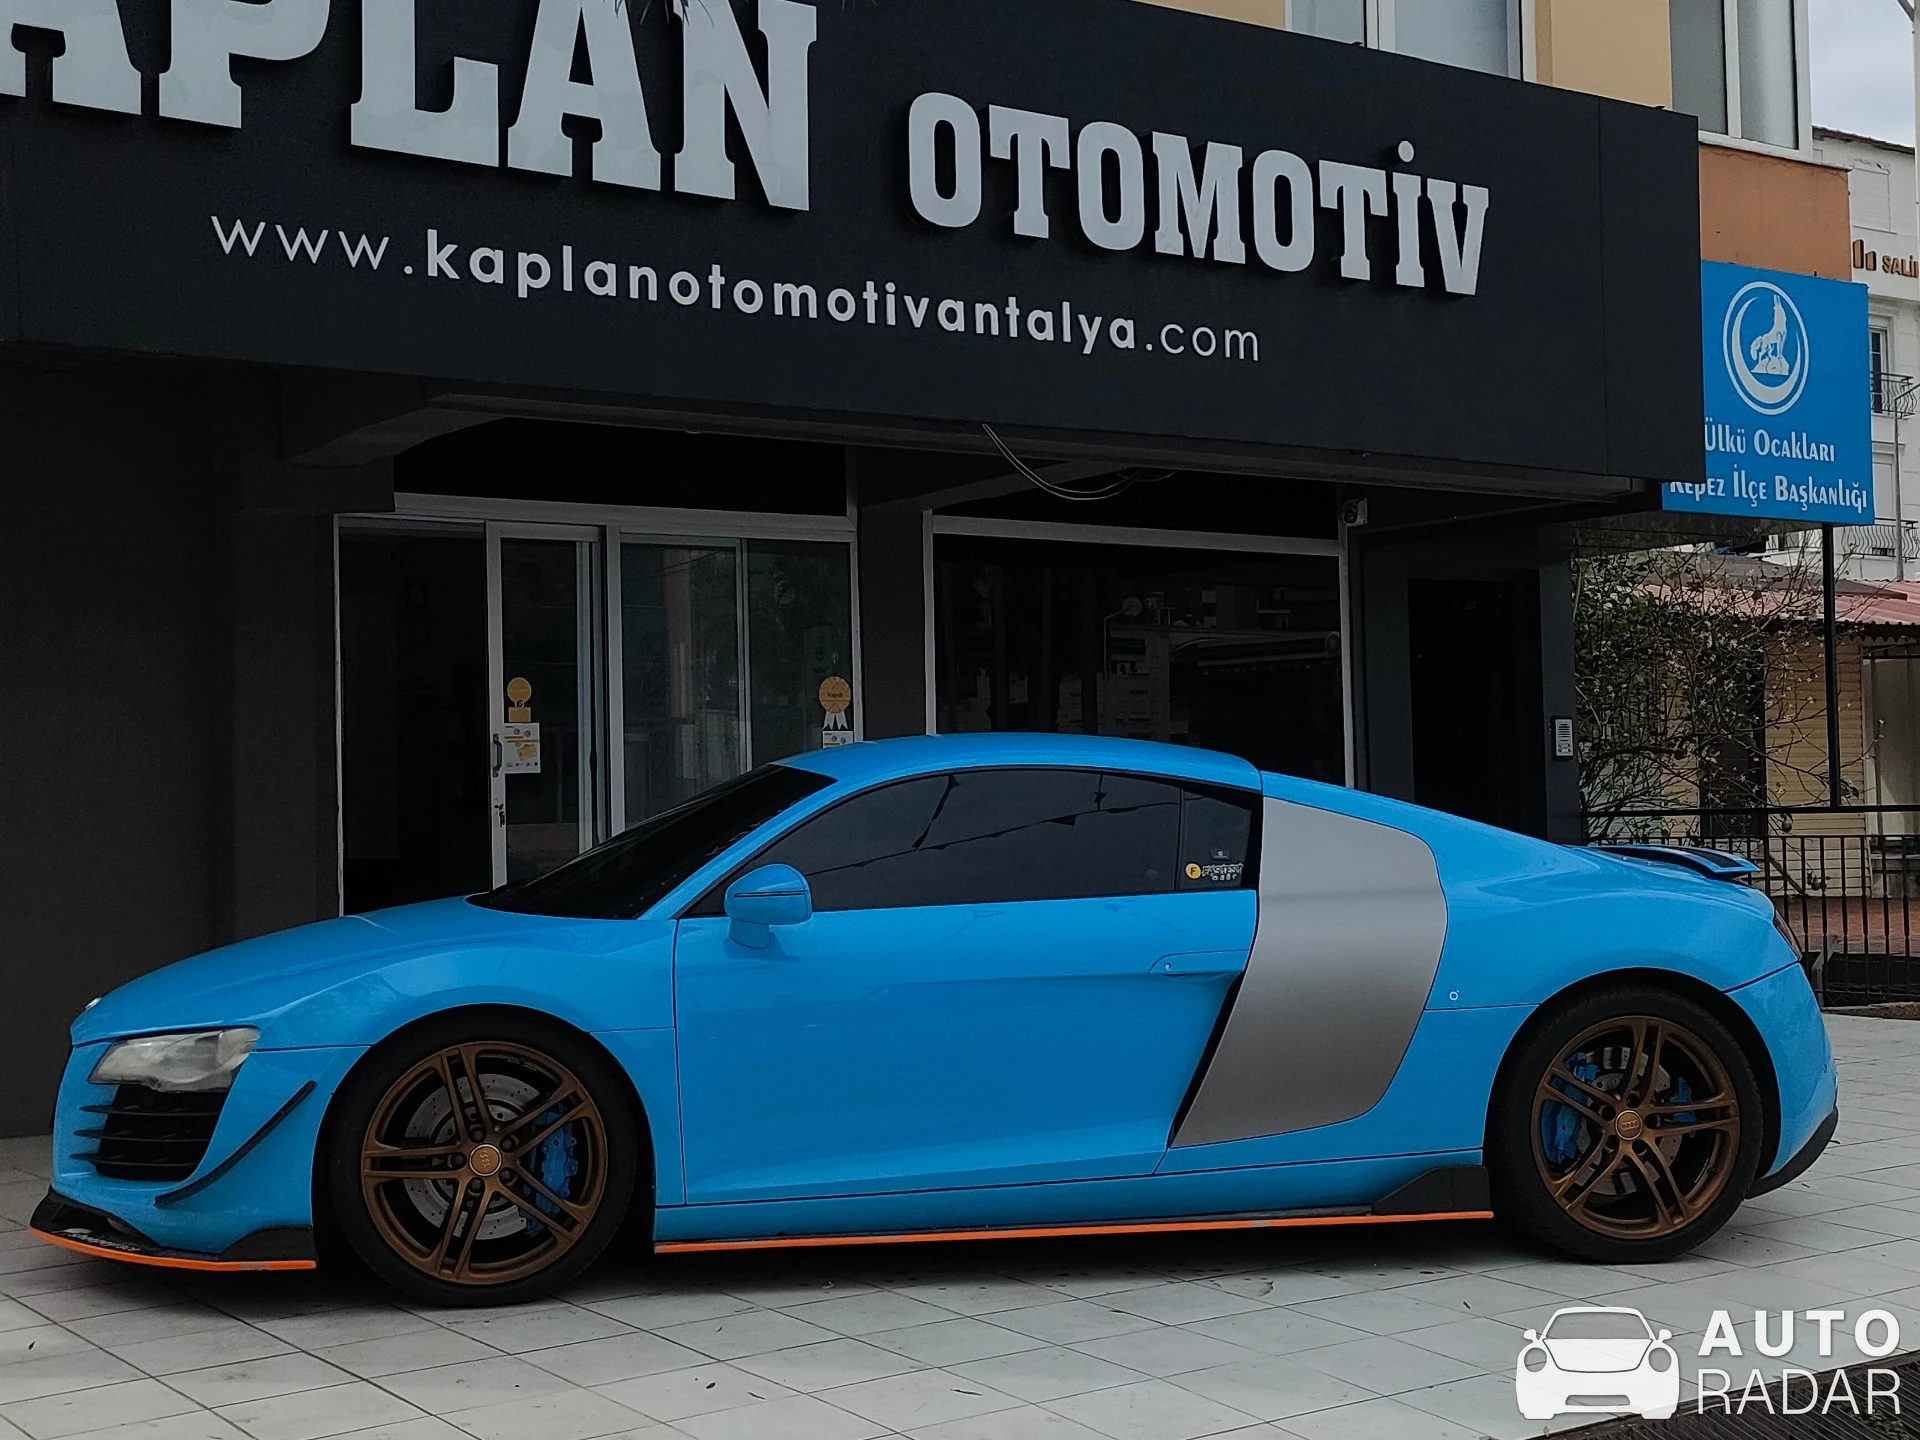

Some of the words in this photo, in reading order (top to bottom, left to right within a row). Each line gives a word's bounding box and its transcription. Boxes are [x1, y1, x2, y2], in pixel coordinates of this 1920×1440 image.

[909, 92, 1489, 296] OTOMOTİV
[1881, 255, 1919, 278] SALİ
[210, 215, 1260, 362] www.kaplanotomotivantalya.com
